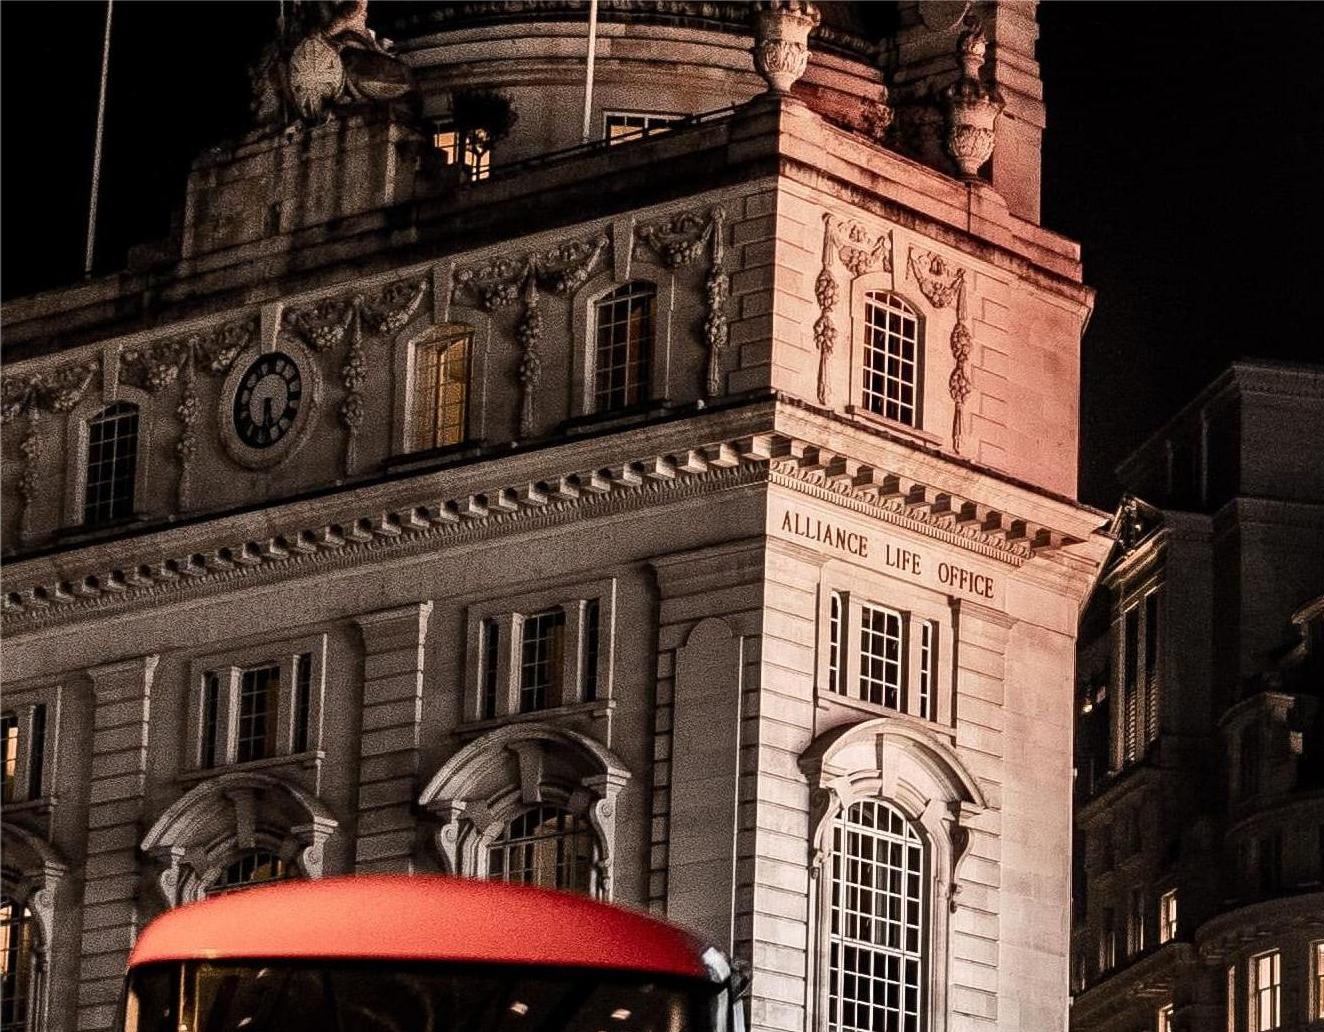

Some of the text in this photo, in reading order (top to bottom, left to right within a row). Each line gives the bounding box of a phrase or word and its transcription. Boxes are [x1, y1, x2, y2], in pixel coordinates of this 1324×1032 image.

[781, 510, 995, 599] ALLIANCE LIFE OFFICE
